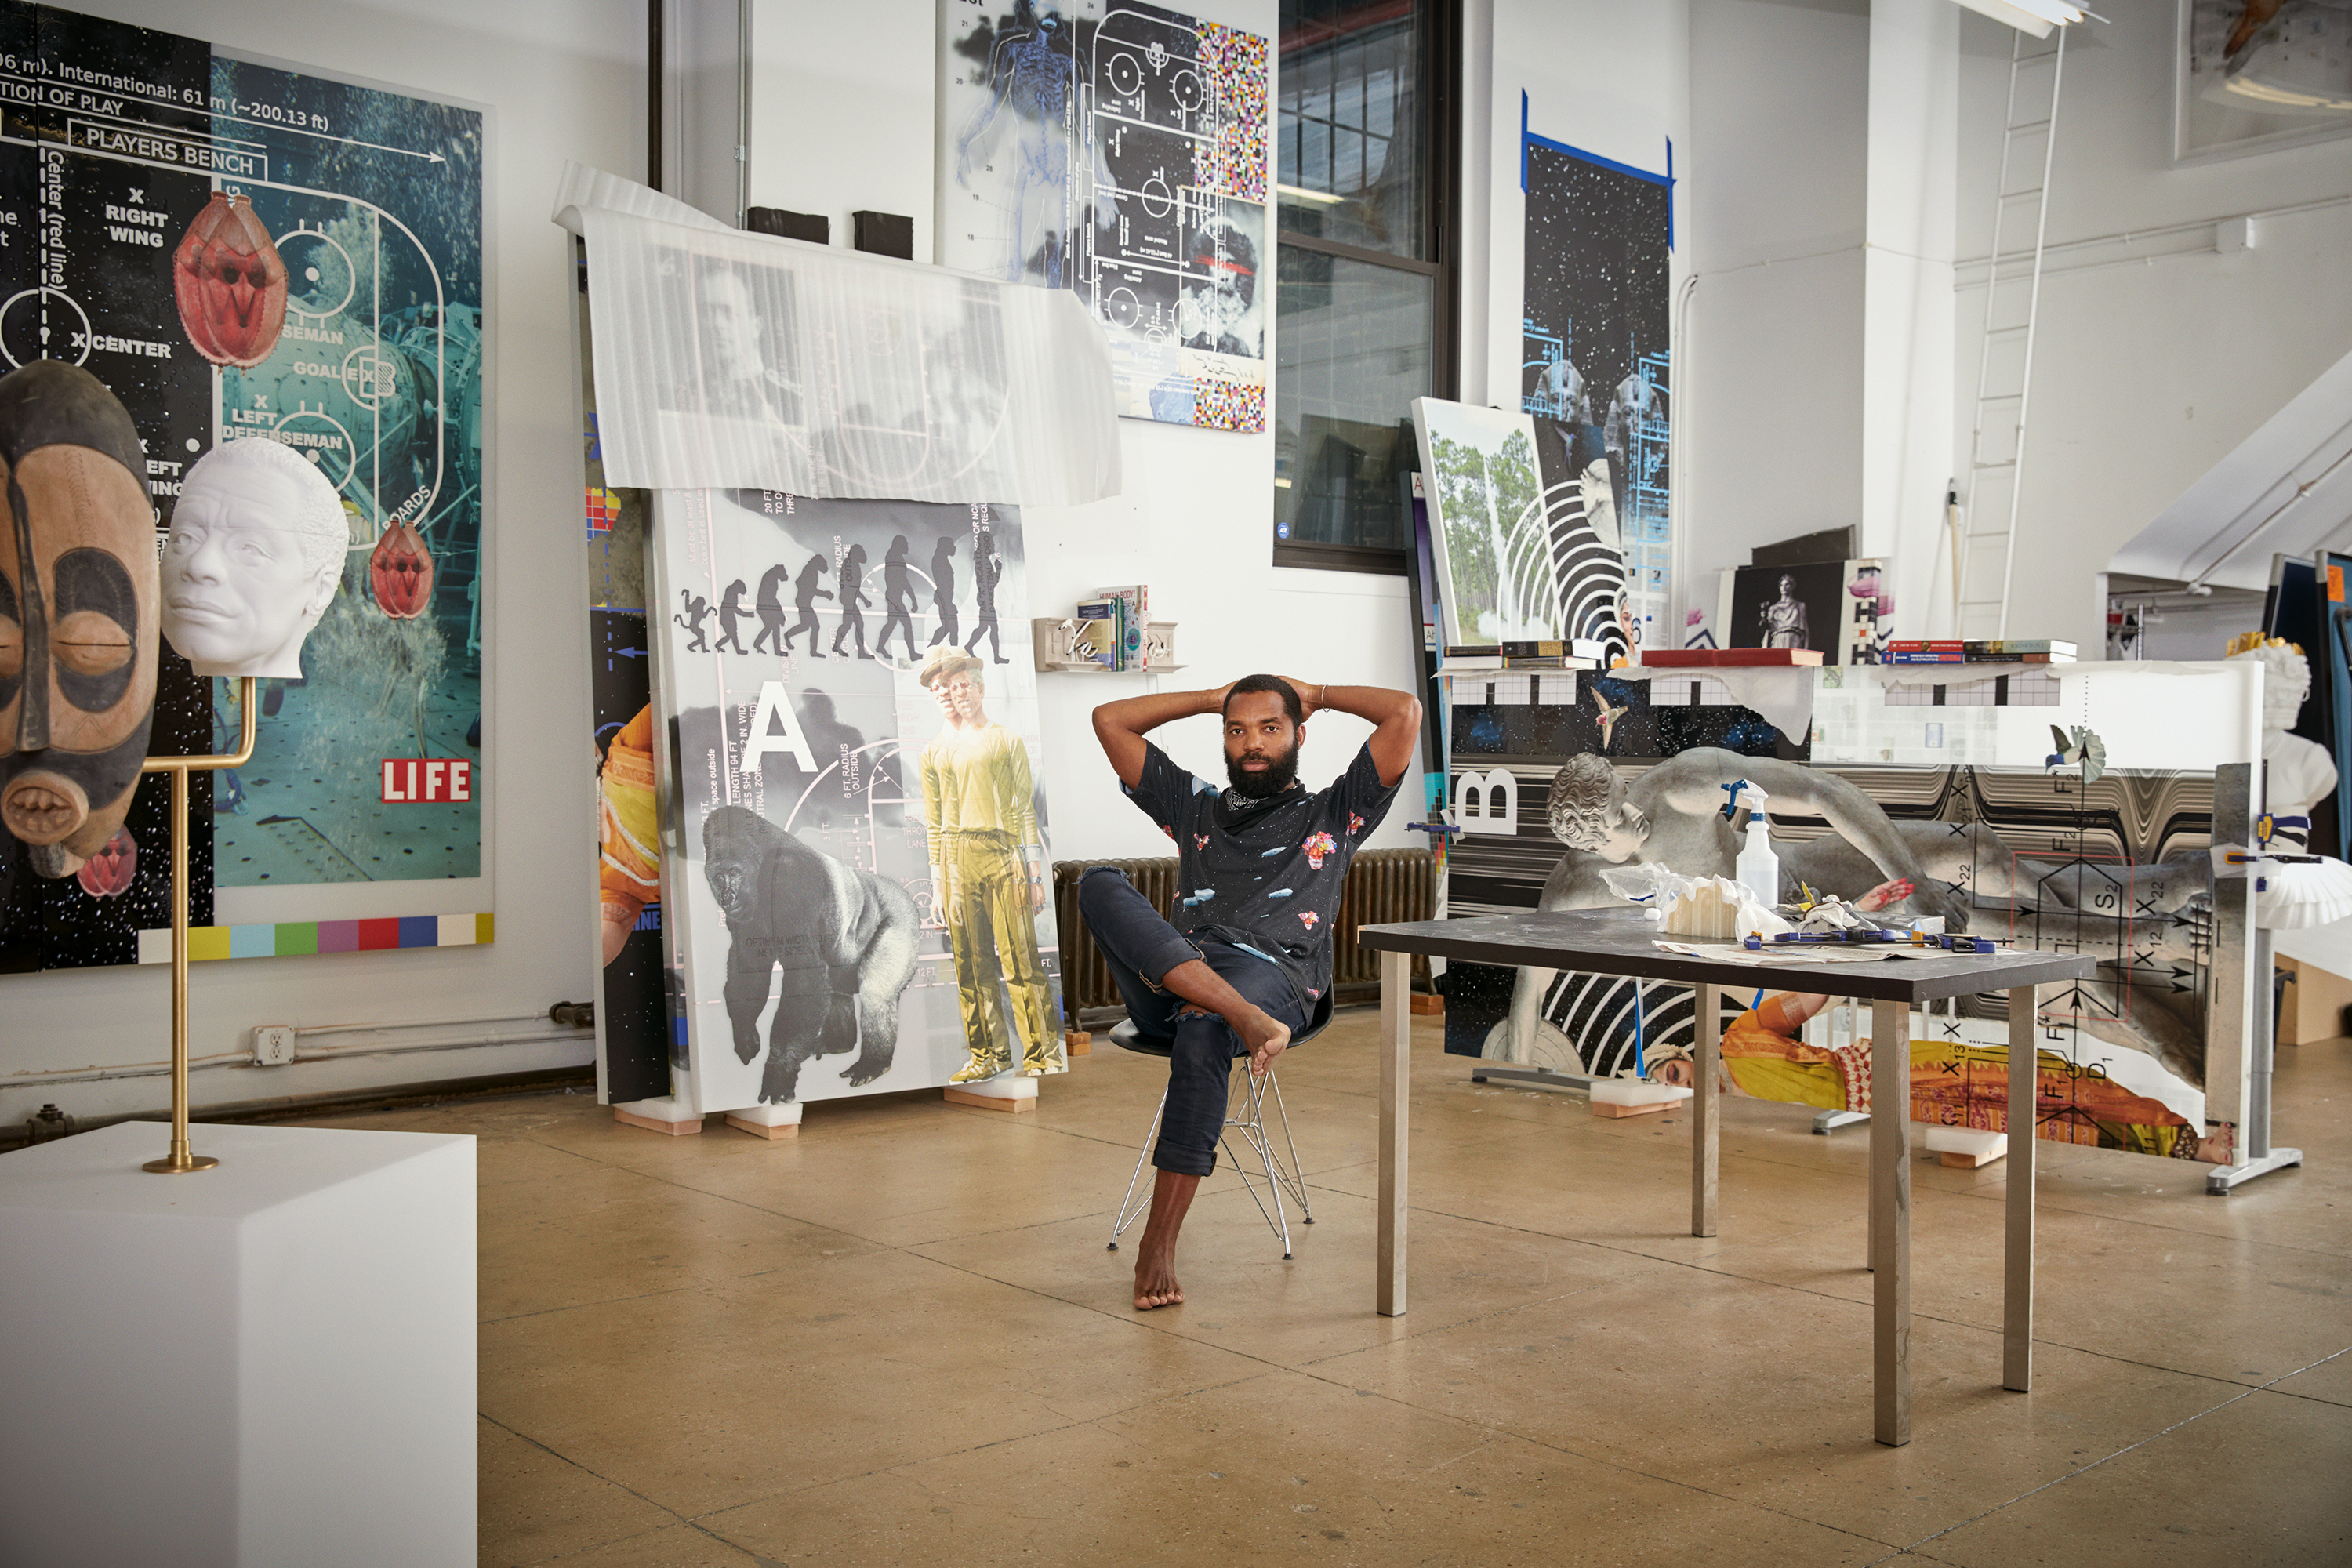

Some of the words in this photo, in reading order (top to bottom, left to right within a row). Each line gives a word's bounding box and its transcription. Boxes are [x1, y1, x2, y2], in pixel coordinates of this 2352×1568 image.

[49, 89, 74, 107] OF
[81, 95, 124, 117] PLAY
[60, 62, 178, 101] International:
[183, 89, 204, 106] 61
[210, 96, 226, 111] m
[231, 98, 307, 125] (~200.13
[311, 114, 329, 132] ft)
[86, 128, 179, 161] PLAYERS
[184, 147, 253, 175] BENCH
[48, 151, 64, 210] Center
[129, 187, 145, 204] X
[105, 205, 169, 229] RIGHT
[47, 213, 67, 249] (red
[109, 226, 165, 249] WING
[48, 252, 68, 290] line)
[92, 336, 172, 359] CENTER
[253, 394, 269, 409] X
[232, 408, 278, 426] LEFT
[146, 459, 183, 477] EFT
[149, 480, 183, 496] ING
[382, 485, 431, 532] BOARDS
[685, 499, 694, 519] least
[696, 498, 705, 517] used
[764, 503, 773, 514] 20
[775, 501, 784, 514] TO
[688, 530, 695, 541] be
[699, 529, 707, 543] belt
[972, 521, 980, 534] OR
[833, 535, 843, 568] RADIUS
[1099, 591, 1120, 600] HUMAN
[1120, 590, 1136, 599] BODY!
[780, 644, 790, 684] DIVISIN
[789, 655, 799, 674] LINE
[738, 700, 747, 724] WIDE
[739, 681, 819, 773] A
[739, 726, 748, 737] IN.
[728, 740, 737, 752] FT
[707, 748, 717, 779] outside
[730, 754, 739, 765] 94
[840, 743, 851, 776] RADIUS
[383, 761, 470, 800] LIFE
[742, 771, 751, 789] SHA
[850, 752, 860, 790] OUTSIDE
[710, 780, 720, 805] space
[731, 768, 741, 804] LENGTH
[843, 779, 851, 791] FT.
[1455, 768, 1518, 836] B
[822, 822, 830, 834] FT.
[906, 839, 927, 848] LANE
[632, 911, 661, 931] INE
[920, 931, 924, 939] 2
[926, 930, 935, 938] IN.
[926, 967, 937, 976] FT.
[1041, 958, 1051, 967] FT.
